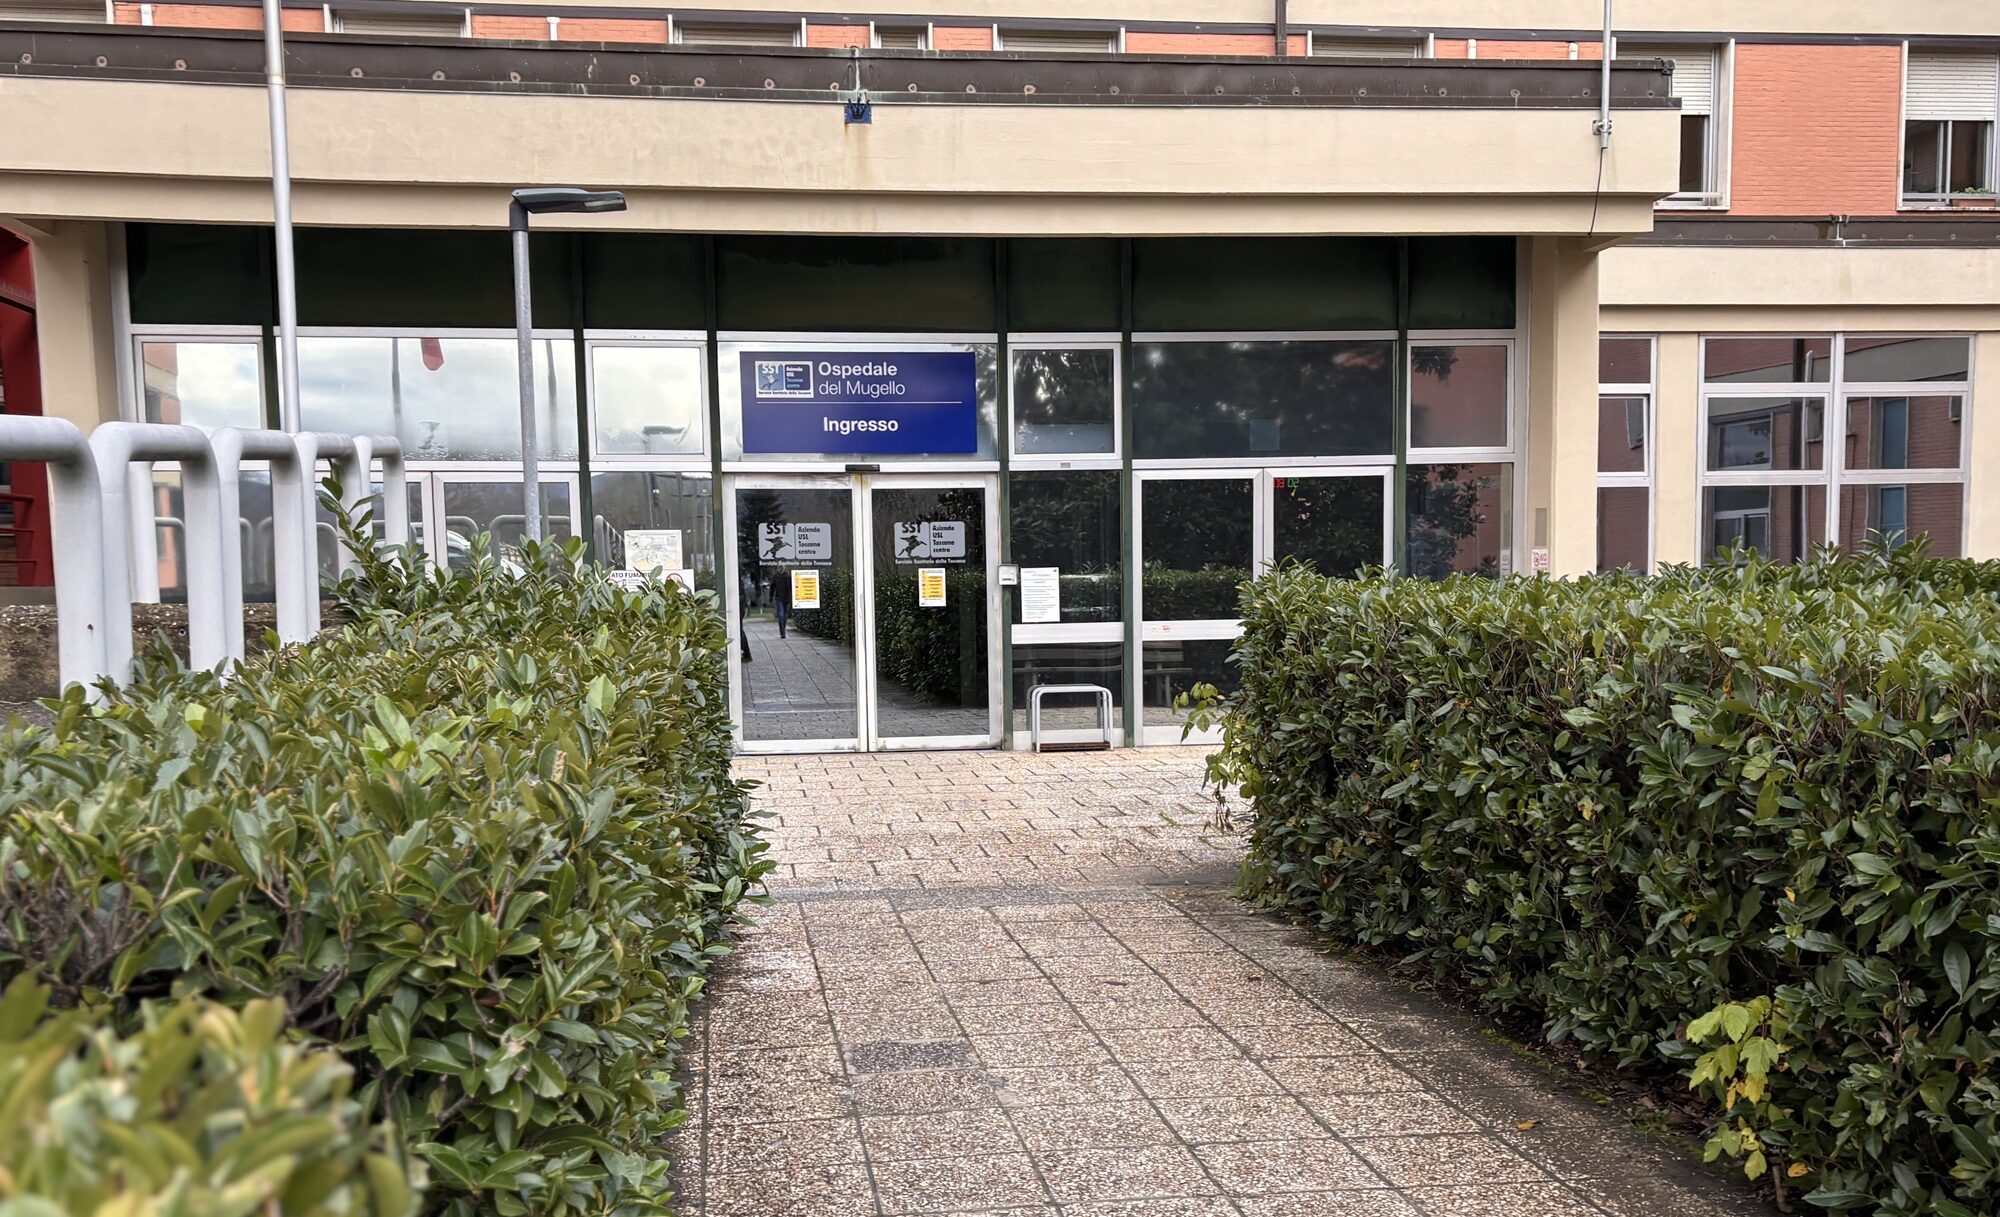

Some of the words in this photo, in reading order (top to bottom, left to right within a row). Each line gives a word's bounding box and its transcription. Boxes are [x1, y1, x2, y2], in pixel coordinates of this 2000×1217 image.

[818, 361, 898, 379] Ospedale
[818, 380, 841, 395] del
[846, 380, 906, 399] Mugello
[823, 416, 899, 435] Ingresso
[766, 520, 787, 534] SST
[902, 520, 922, 533] SST
